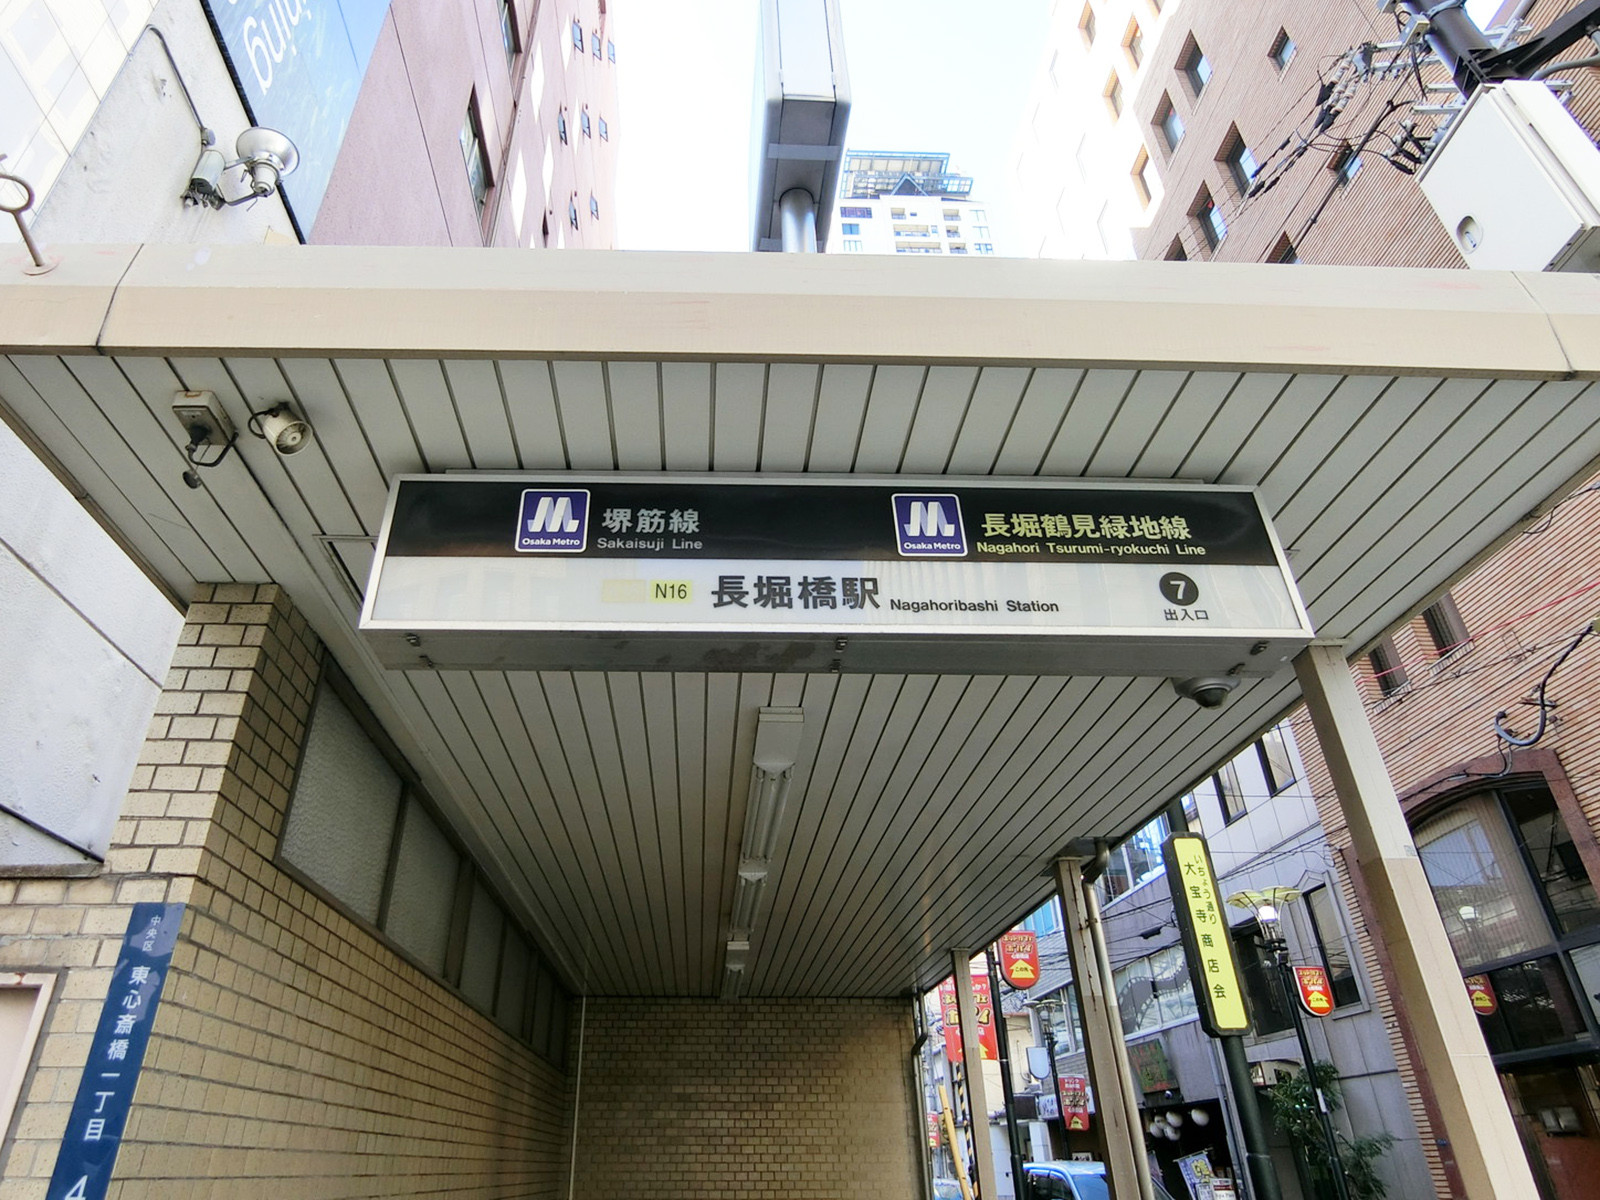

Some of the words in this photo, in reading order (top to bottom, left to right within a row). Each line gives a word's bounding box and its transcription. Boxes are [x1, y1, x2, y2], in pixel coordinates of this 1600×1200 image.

[602, 508, 700, 534] 堺筋線
[981, 513, 1192, 540] 長堀鶴見緑地線
[522, 537, 551, 546] Osaka
[552, 537, 580, 546] Metro
[597, 537, 664, 552] Sakaisuji
[672, 538, 703, 549] Line
[904, 542, 932, 550] Osaka
[934, 542, 961, 550] Metro
[976, 541, 1040, 555] Nagahori
[1046, 542, 1170, 556] Tsurumi-ryokuchi
[1175, 544, 1206, 555] Line
[655, 583, 687, 599] N16
[711, 575, 881, 610] 長堀橋駅
[1169, 580, 1186, 600] 7
[890, 599, 998, 613] Nagahoribashi
[1006, 600, 1059, 612] Station
[1163, 608, 1209, 621] 出入口
[1194, 854, 1217, 925] いちょう通り
[142, 915, 161, 951] 中央区
[1184, 861, 1227, 999] 大宝寺商店会
[84, 965, 151, 1142] 東心斎橋一丁目
[64, 1174, 88, 1200] 4
